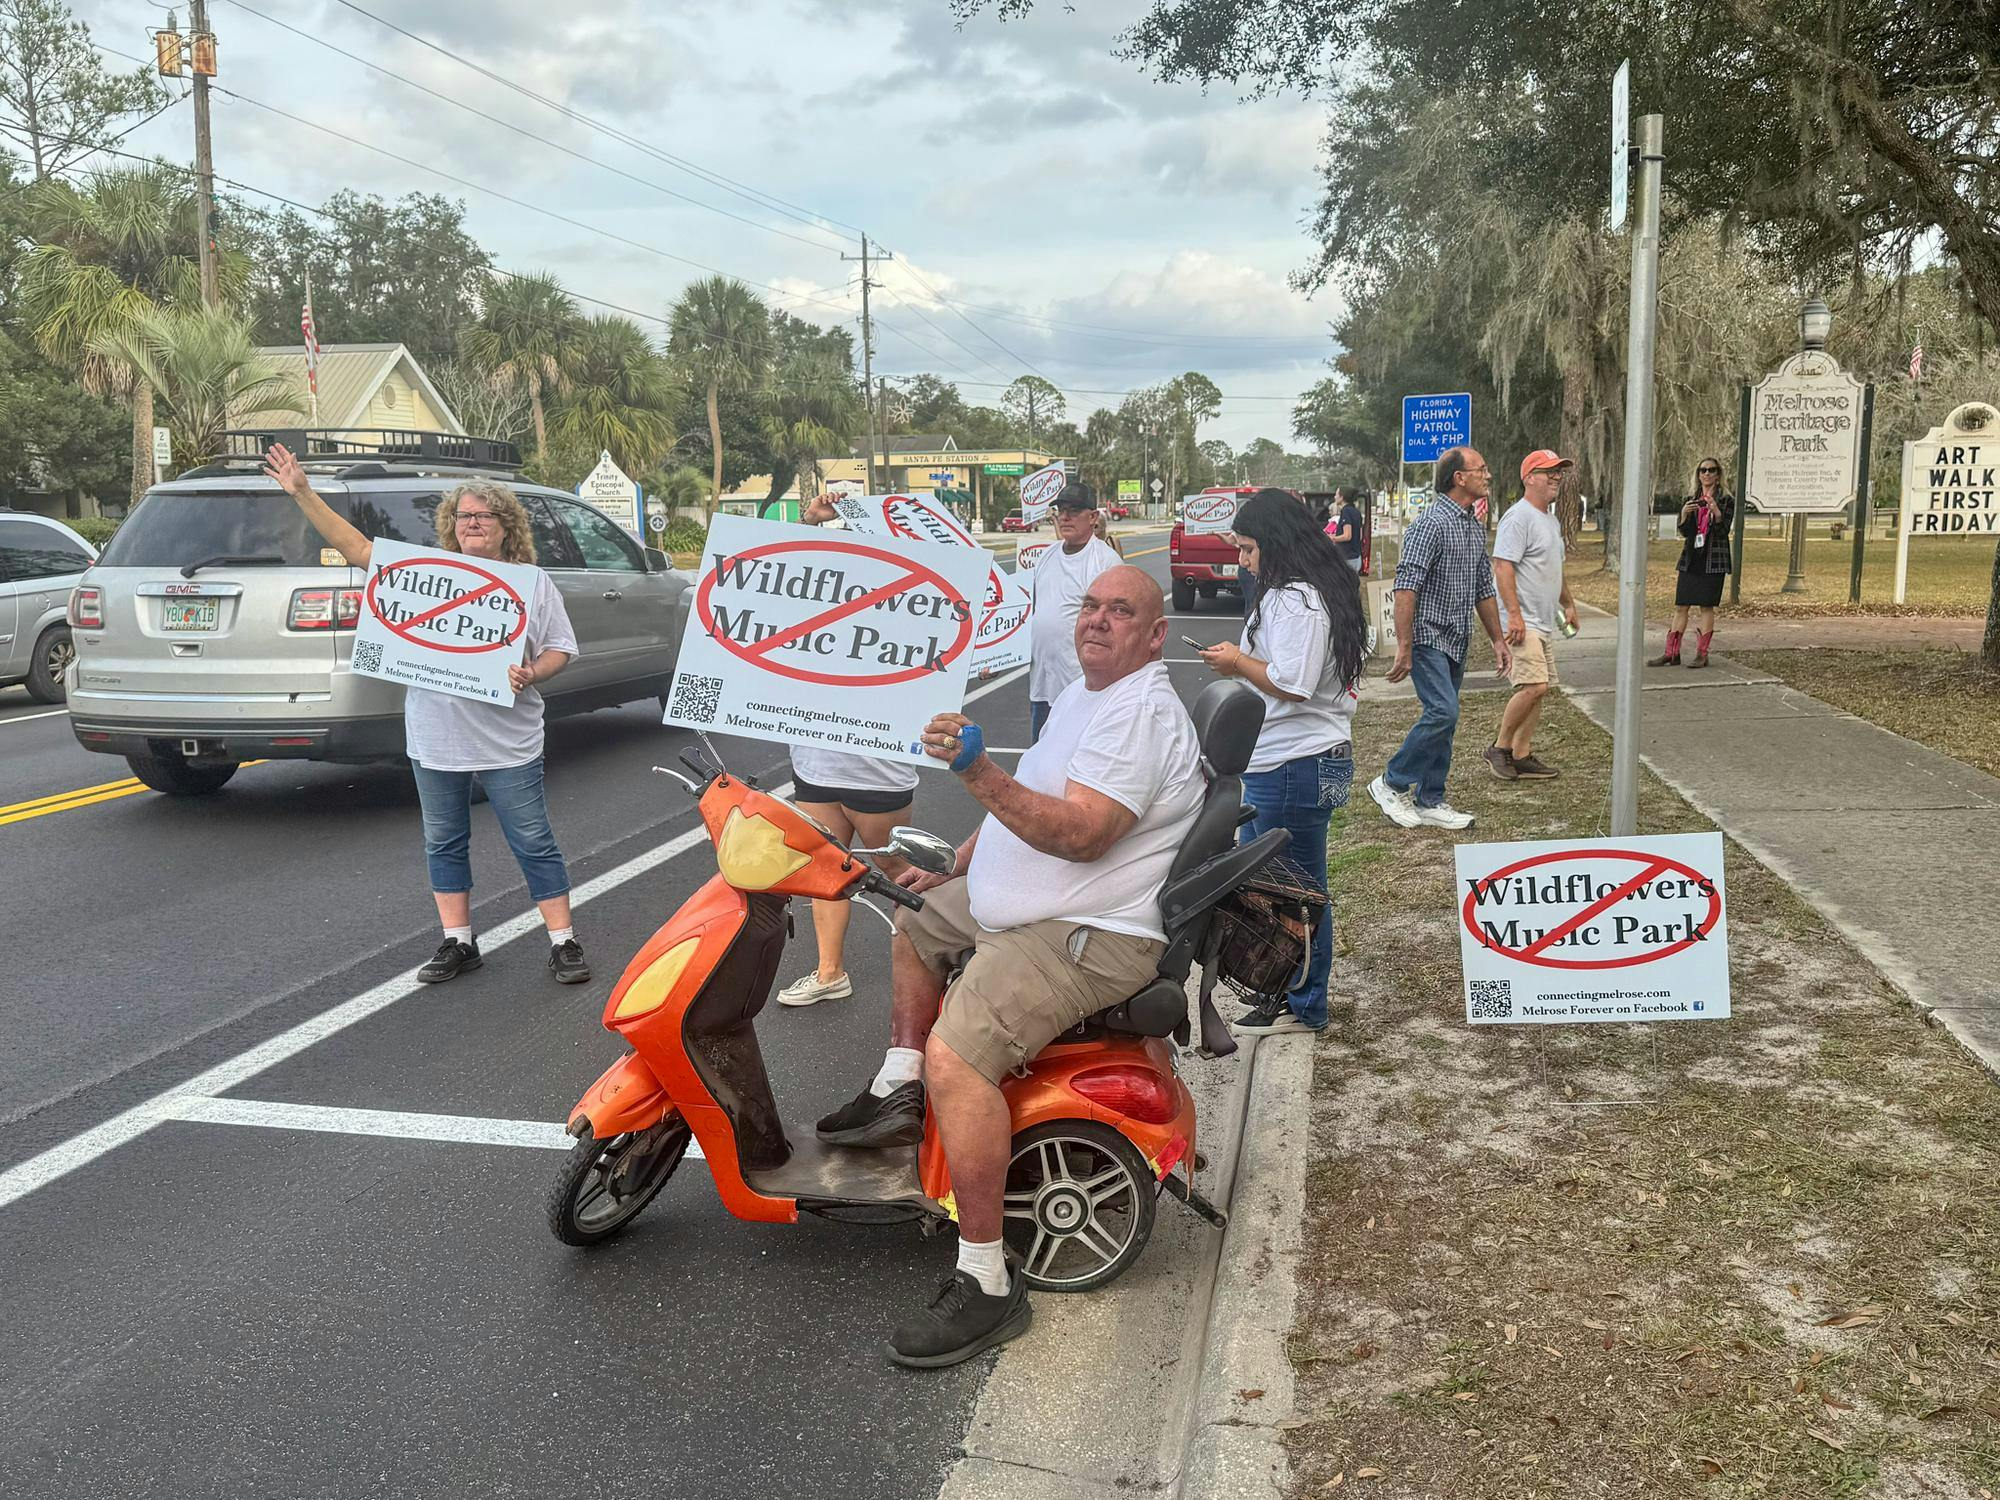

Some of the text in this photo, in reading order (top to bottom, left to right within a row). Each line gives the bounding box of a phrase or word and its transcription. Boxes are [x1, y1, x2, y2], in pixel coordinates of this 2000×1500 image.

[1420, 399, 1454, 407] FLORIDA
[1763, 393, 1849, 412] Melrose
[1411, 408, 1462, 420] HIGHWAY
[1760, 412, 1851, 433] Heritage
[1414, 421, 1458, 433] PATROL
[1408, 438, 1426, 446] DIAL
[1779, 434, 1829, 453] Park
[903, 455, 929, 463] SANTA
[932, 455, 943, 463] FE
[1935, 446, 1981, 465] ART
[595, 473, 618, 481] Trinity
[1929, 468, 1995, 487] WALK
[1930, 491, 1994, 509] FIRST
[1912, 513, 1997, 532] FRIDAY
[165, 585, 201, 594] GMC
[375, 563, 526, 616] Wildflowers
[712, 553, 971, 623] Wildflowers
[454, 614, 513, 647] Park
[994, 610, 1026, 633] Park
[846, 625, 949, 673] Park
[397, 659, 481, 683] connectingmelrose.com
[384, 667, 488, 696] Melrose Forever on Facebook
[746, 700, 891, 732] connectingmelrose.com
[725, 713, 905, 752] Melrose Forever on Facebook
[1466, 874, 1716, 906] Wildflowers
[1612, 914, 1708, 945] Park
[1537, 989, 1671, 1001] connectingmelrose.com
[1522, 1002, 1688, 1016] Melrose Forever on Facebook
